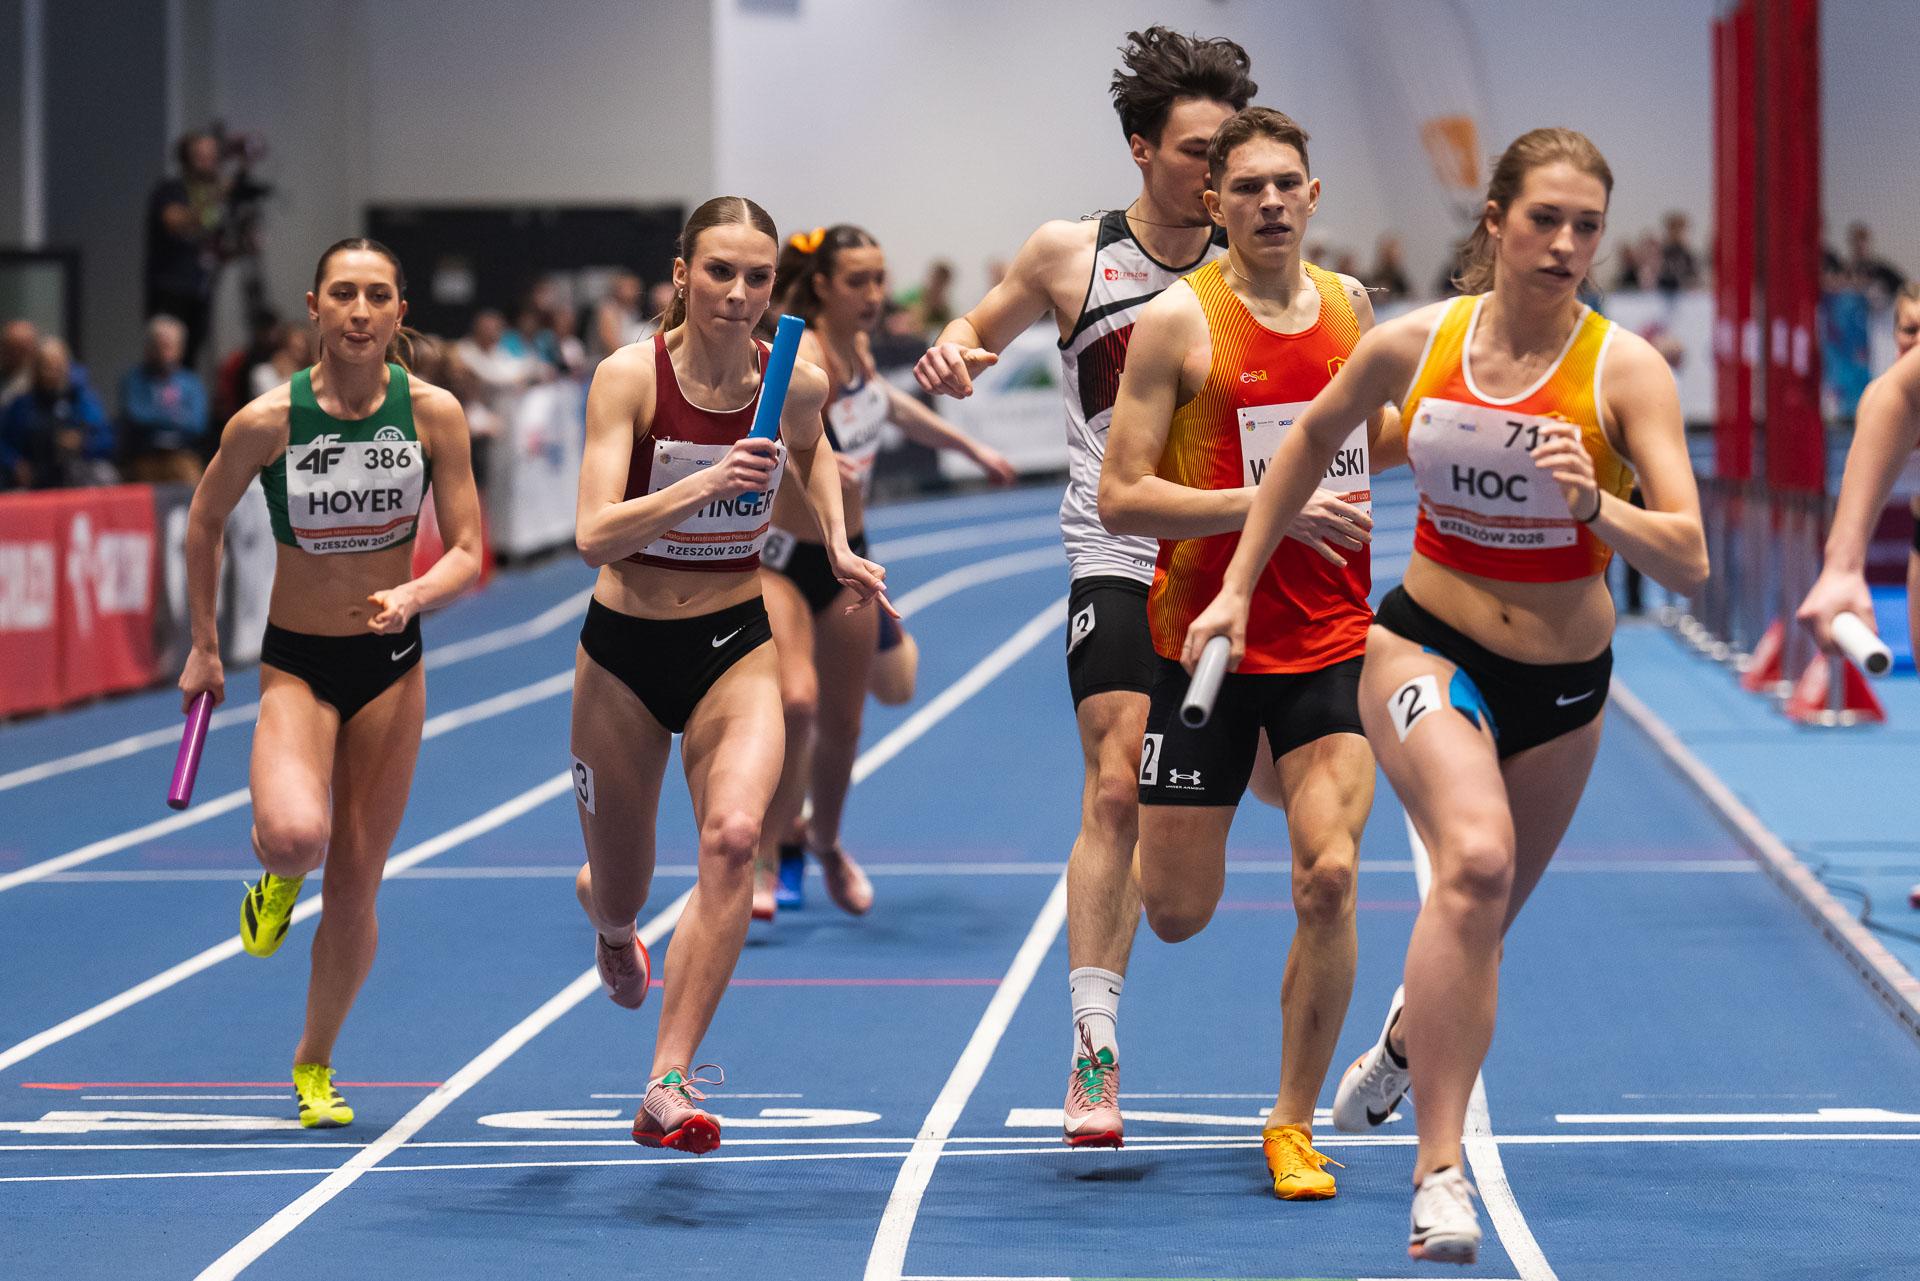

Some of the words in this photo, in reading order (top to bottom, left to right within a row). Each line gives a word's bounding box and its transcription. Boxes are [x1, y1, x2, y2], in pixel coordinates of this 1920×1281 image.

[381, 432, 399, 441] AZS
[1505, 421, 1551, 451] 71
[364, 448, 411, 469] 386
[1452, 464, 1528, 502] HOC
[309, 488, 403, 515] HOYER
[313, 538, 369, 551] RZESZÓW
[371, 532, 395, 546] 2026
[692, 533, 731, 541] Mistrzostwa
[1439, 520, 1504, 543] RZESZÓW
[1508, 533, 1545, 544] 2026
[667, 545, 726, 556] RZESZÓW
[727, 544, 753, 555] 2026
[1077, 613, 1089, 632] 2
[1398, 685, 1427, 729] 2
[1141, 738, 1155, 780] 2
[576, 763, 588, 804] 3
